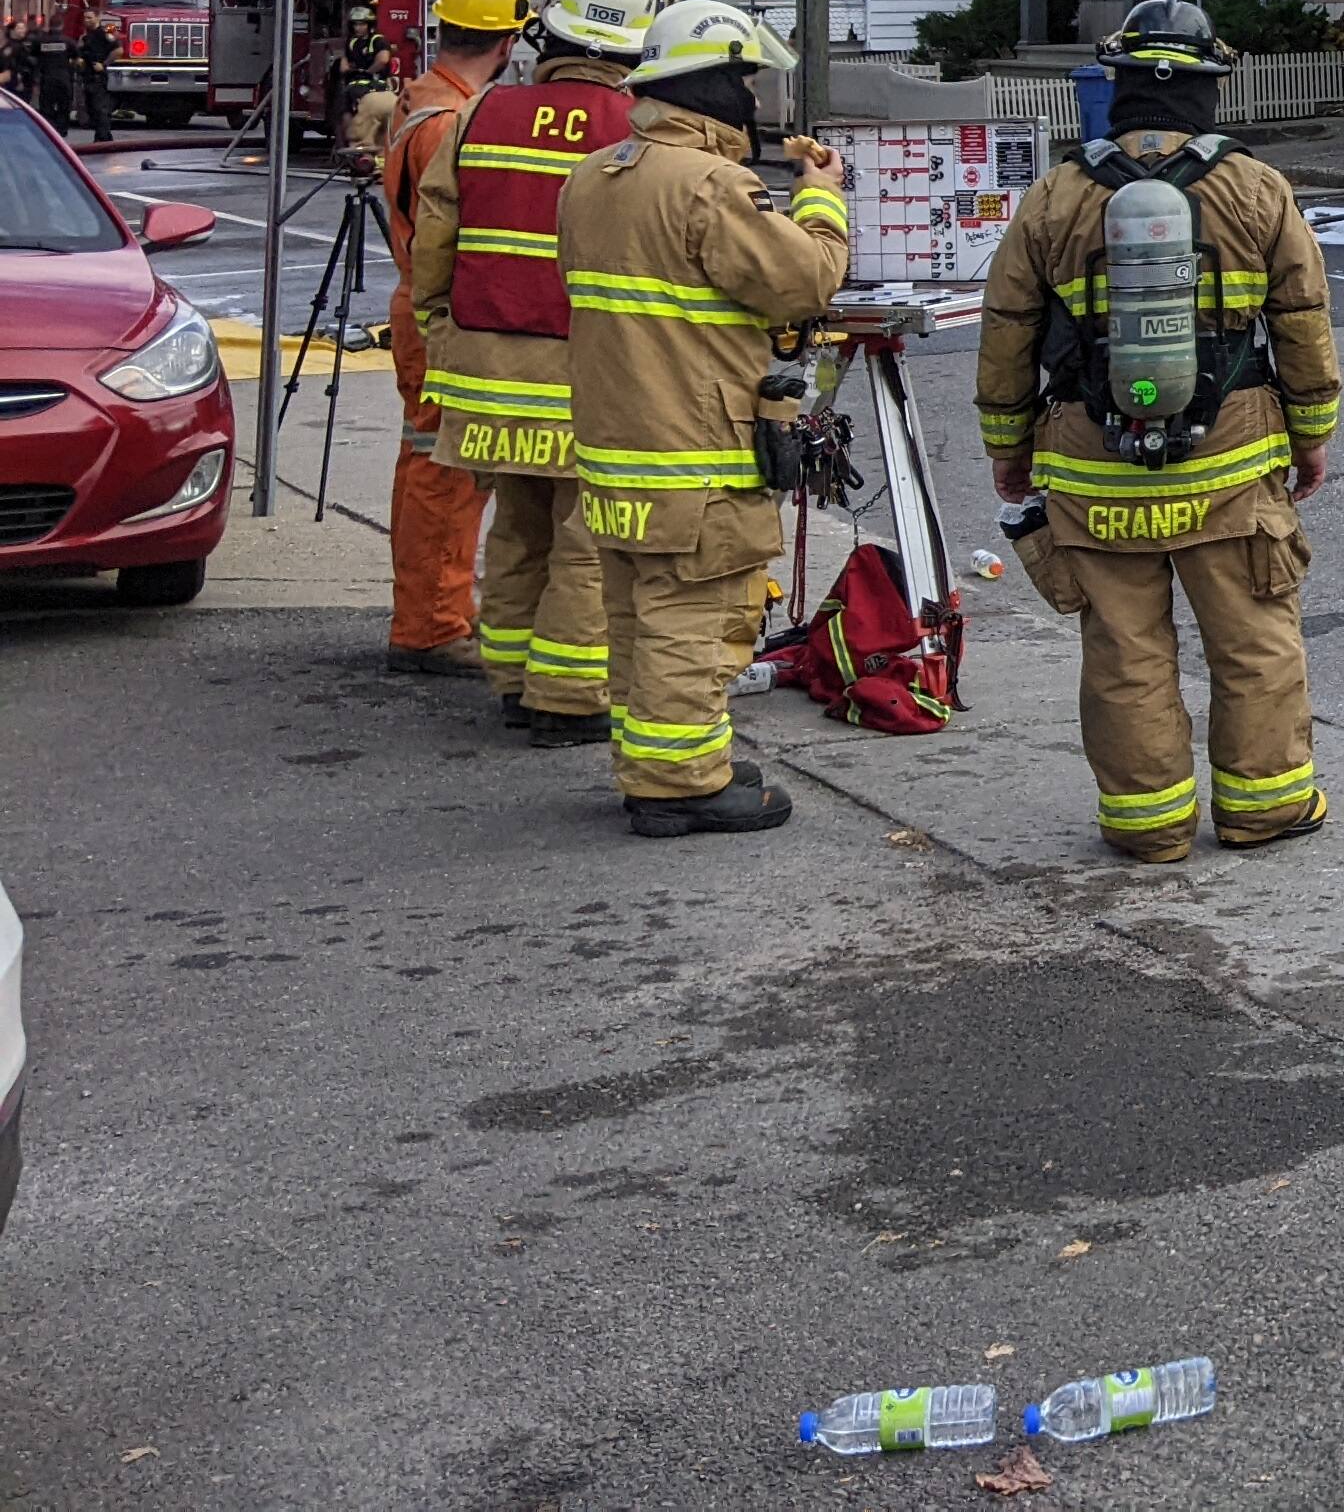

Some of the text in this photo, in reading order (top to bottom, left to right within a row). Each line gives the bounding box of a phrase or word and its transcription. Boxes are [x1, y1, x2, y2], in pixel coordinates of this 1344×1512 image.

[591, 8, 620, 23] 105
[1144, 317, 1190, 336] MSA
[460, 423, 575, 467] GRANBY
[1087, 497, 1212, 541] GRANBY
